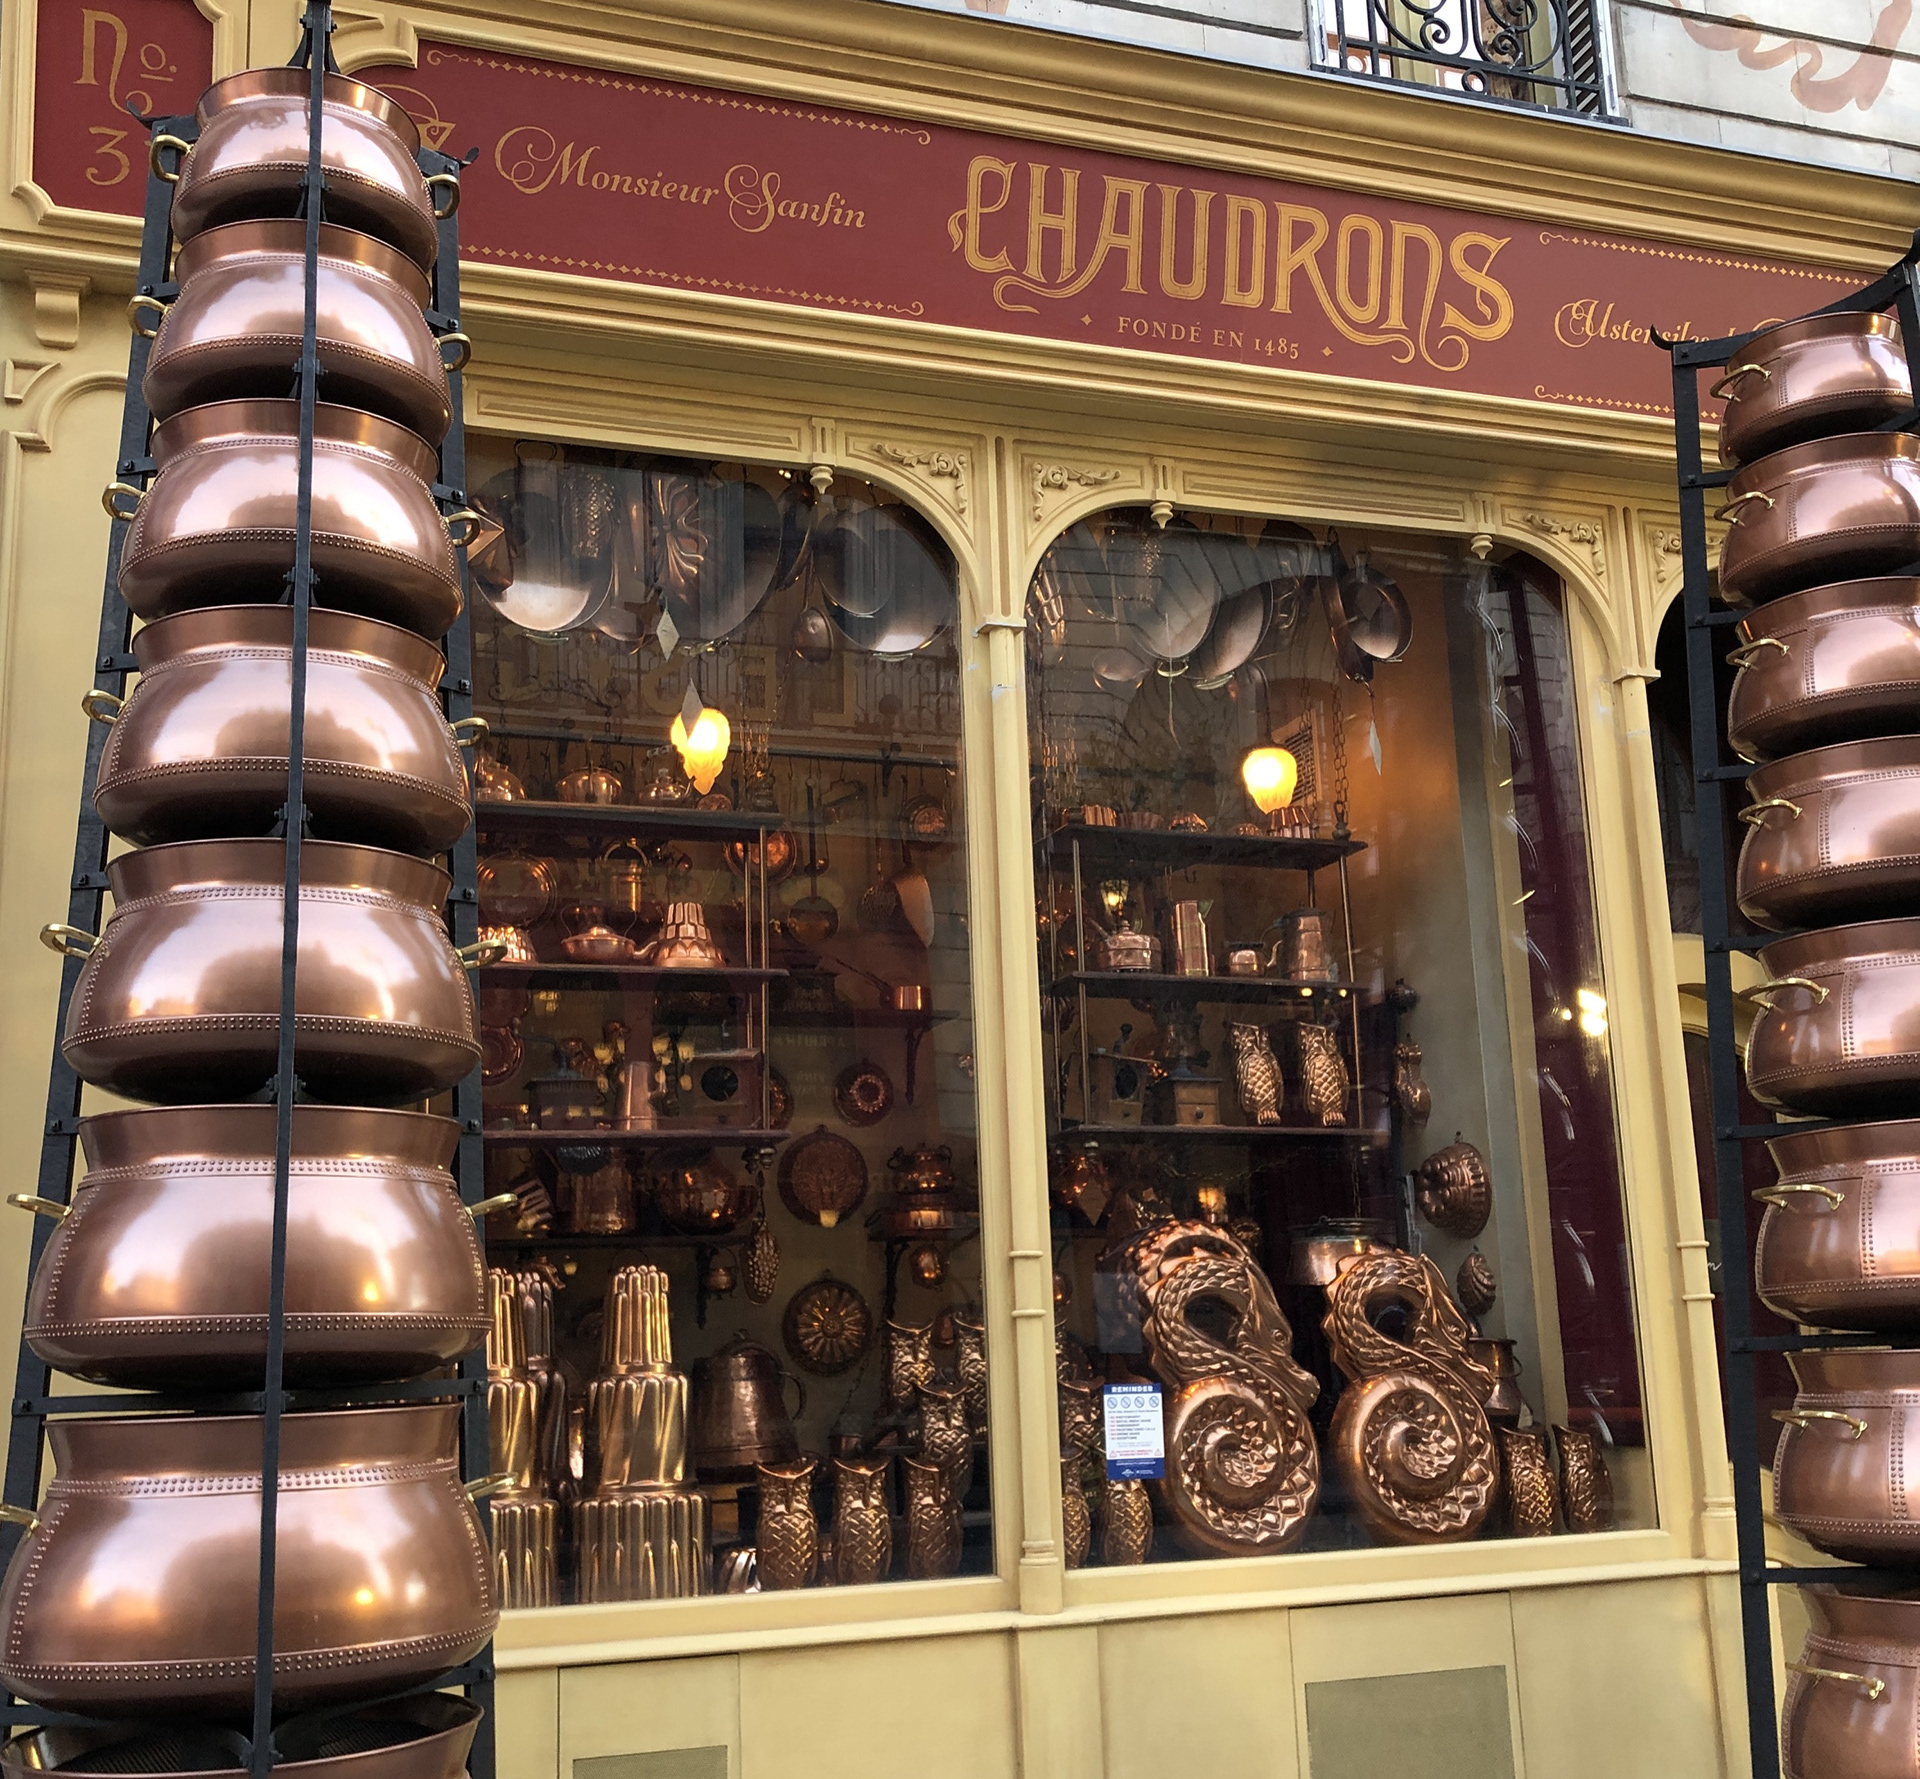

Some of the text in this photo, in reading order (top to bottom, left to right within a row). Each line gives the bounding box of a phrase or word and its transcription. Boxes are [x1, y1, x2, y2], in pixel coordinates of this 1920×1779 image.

[494, 125, 867, 233] Monsieur Sanfin
[947, 155, 1515, 372] CHAUDRONS
[1117, 315, 1300, 360] FONDÉ EN 1485
[1111, 1385, 1154, 1393] REMINDER
